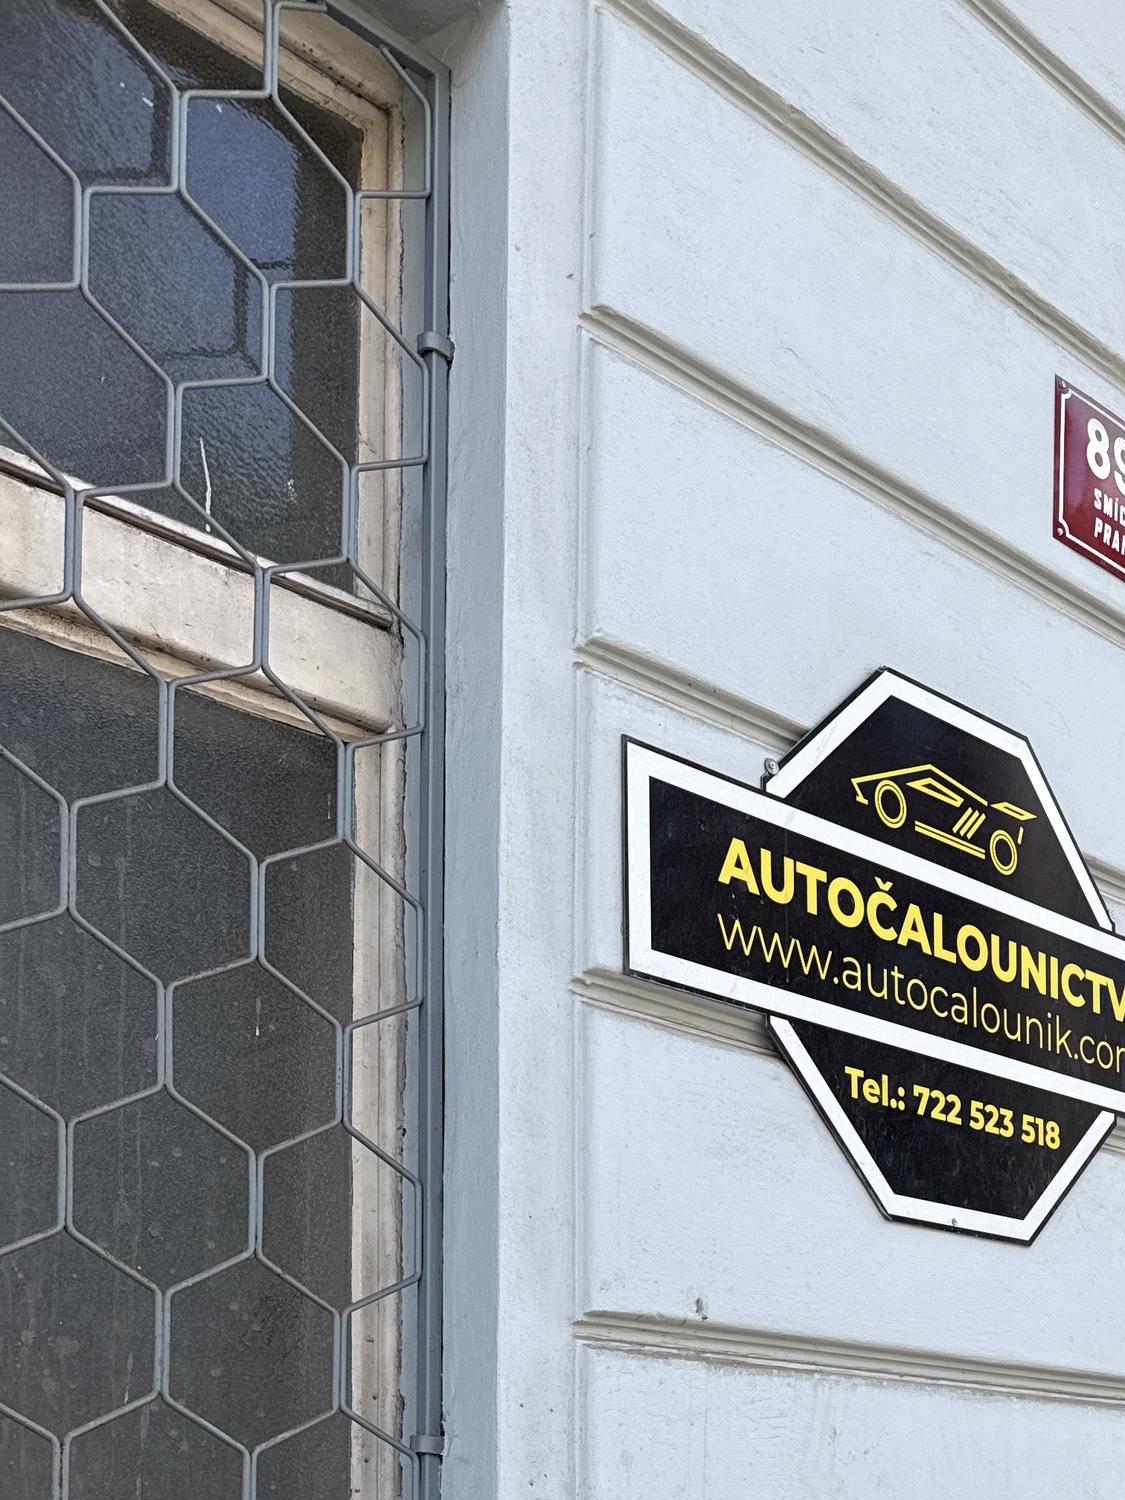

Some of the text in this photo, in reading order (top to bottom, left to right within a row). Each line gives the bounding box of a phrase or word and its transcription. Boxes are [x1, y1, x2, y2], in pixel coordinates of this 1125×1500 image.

[844, 1065, 1061, 1150] Tel.: 722 523 518
